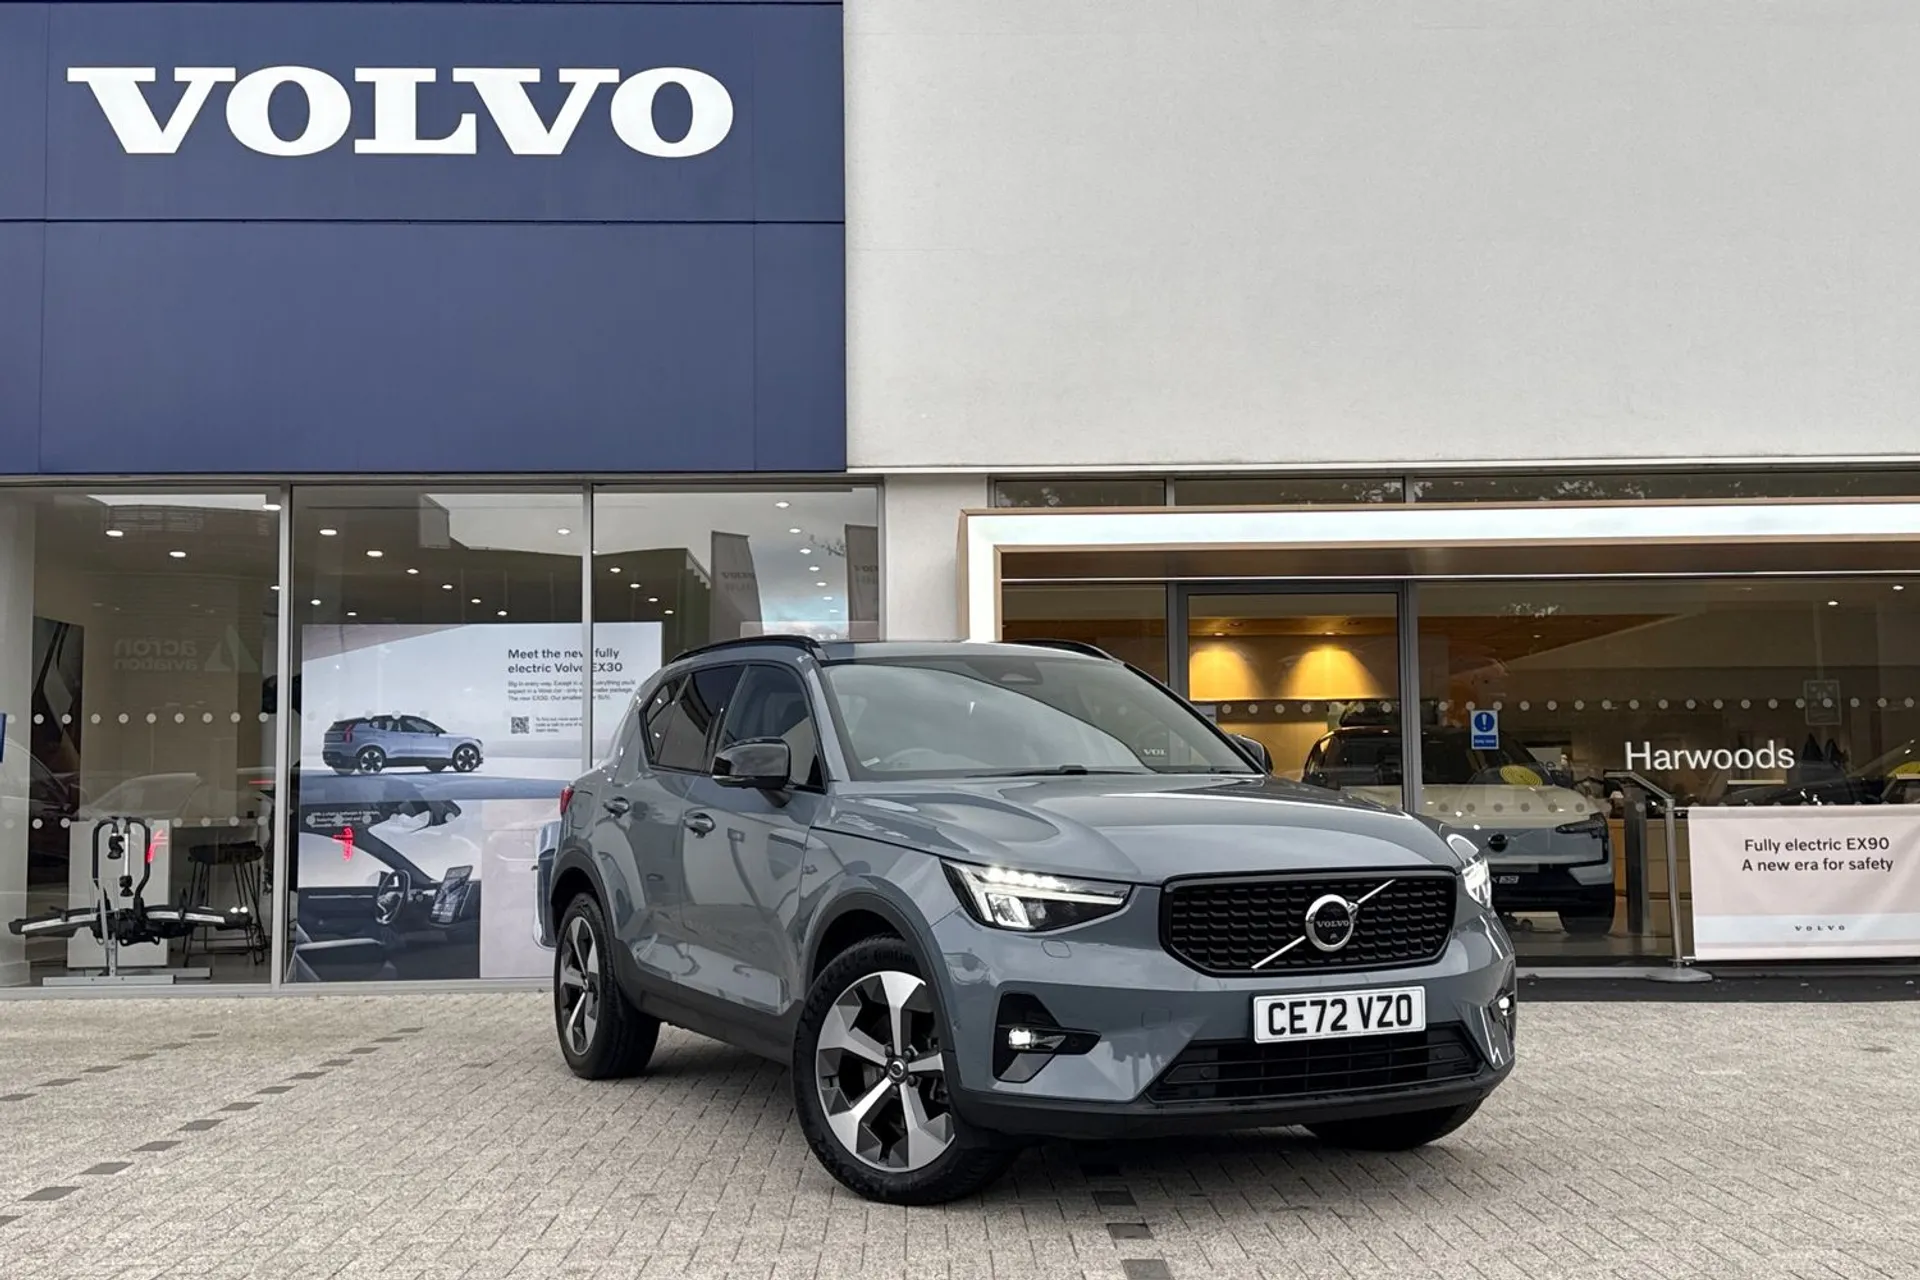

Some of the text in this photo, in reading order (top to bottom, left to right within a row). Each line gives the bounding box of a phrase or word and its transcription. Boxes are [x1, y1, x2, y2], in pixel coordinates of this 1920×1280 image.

[67, 65, 734, 158] VOLVO
[508, 649, 539, 659] Meet
[542, 648, 561, 659] the
[595, 648, 619, 660] fully
[508, 663, 551, 673] electric
[1624, 739, 1795, 771] Harwoods
[1744, 837, 1890, 854] Fully electric EX90
[1742, 857, 1894, 872] A new era for safety
[1316, 920, 1350, 928] VOLVO
[1794, 924, 1846, 932] VOLVO
[1268, 994, 1412, 1035] CE72 VZO
